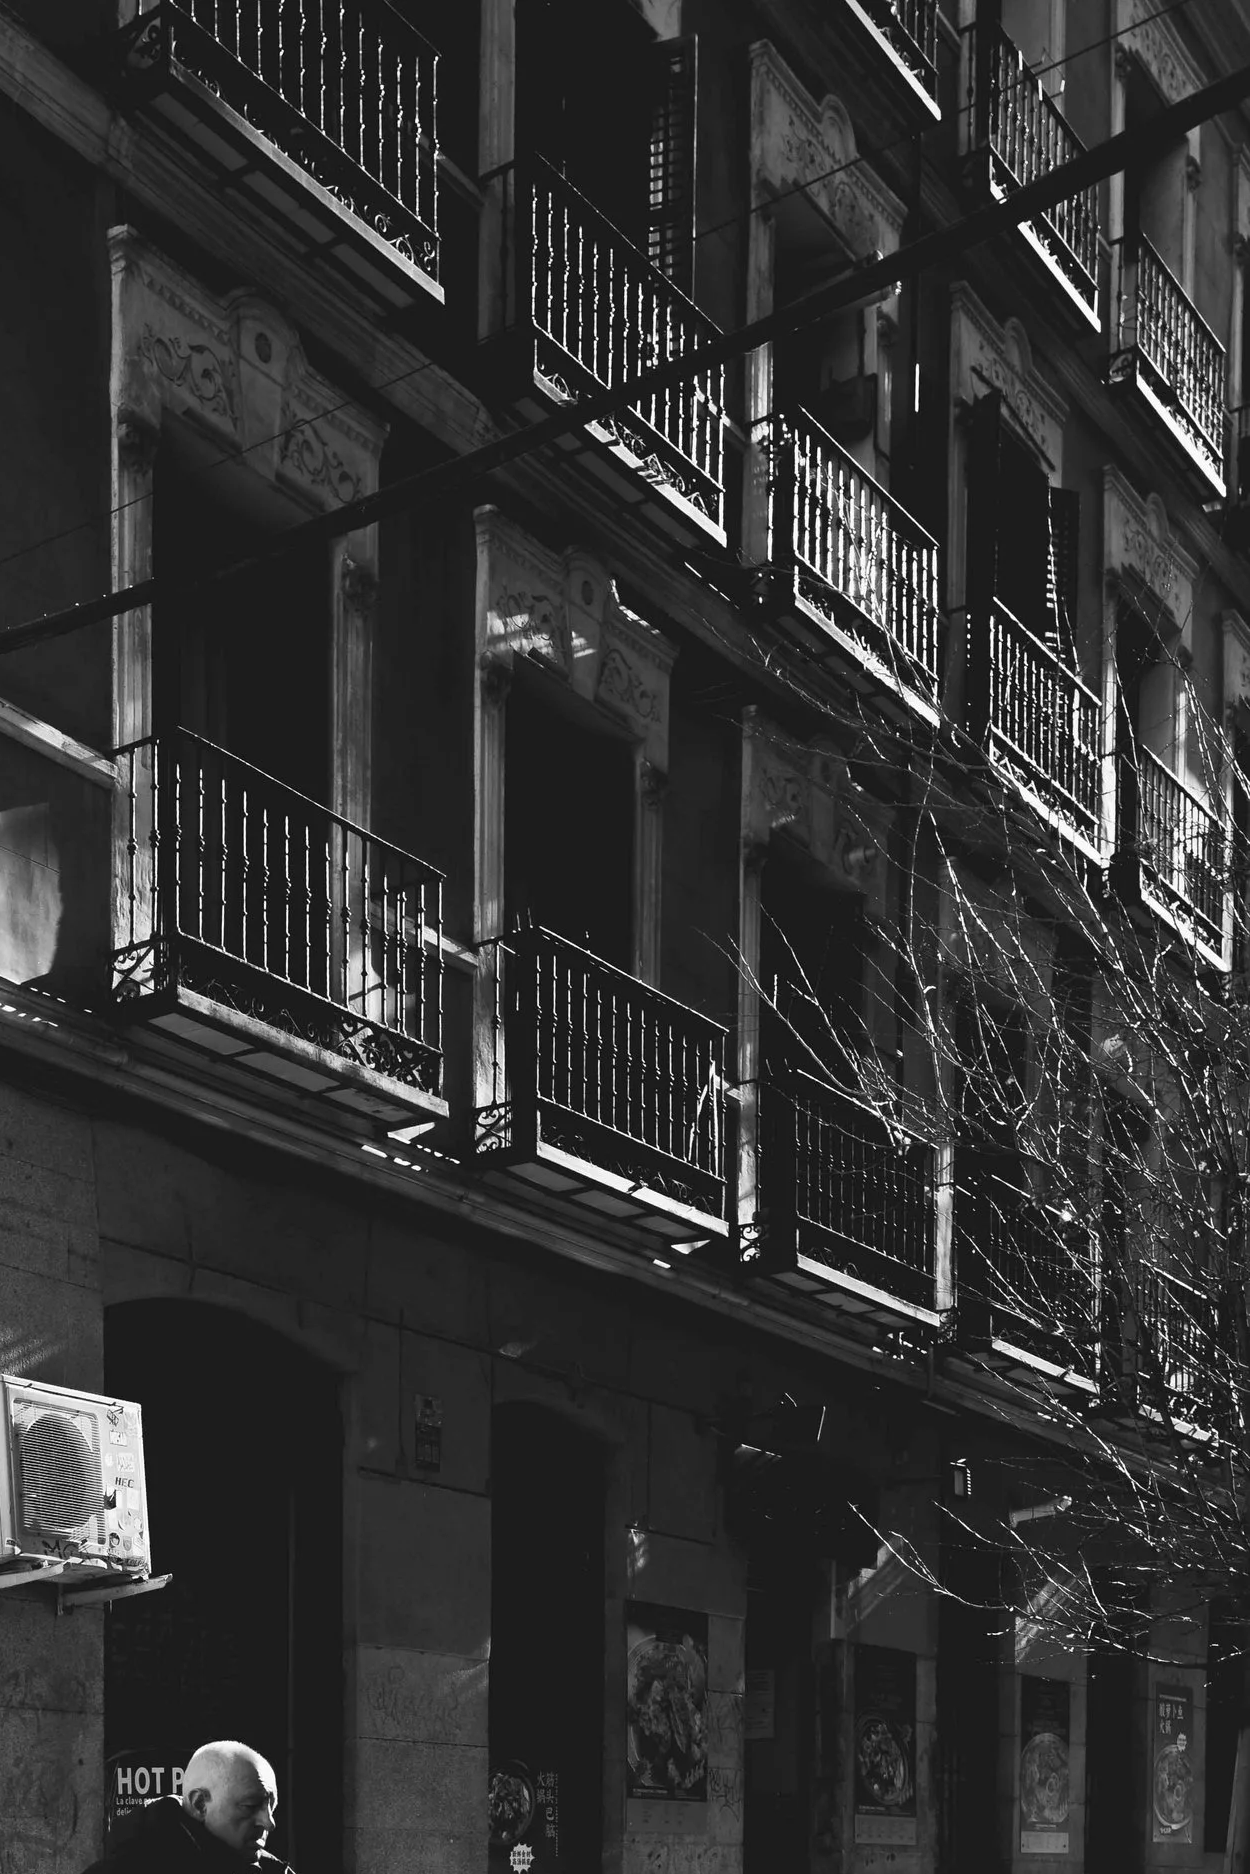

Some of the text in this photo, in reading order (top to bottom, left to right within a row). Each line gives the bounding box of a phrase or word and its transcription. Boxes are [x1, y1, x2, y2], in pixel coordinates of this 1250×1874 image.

[117, 1766, 165, 1795] HOT
[116, 1797, 124, 1805] La
[125, 1796, 143, 1805] clave
